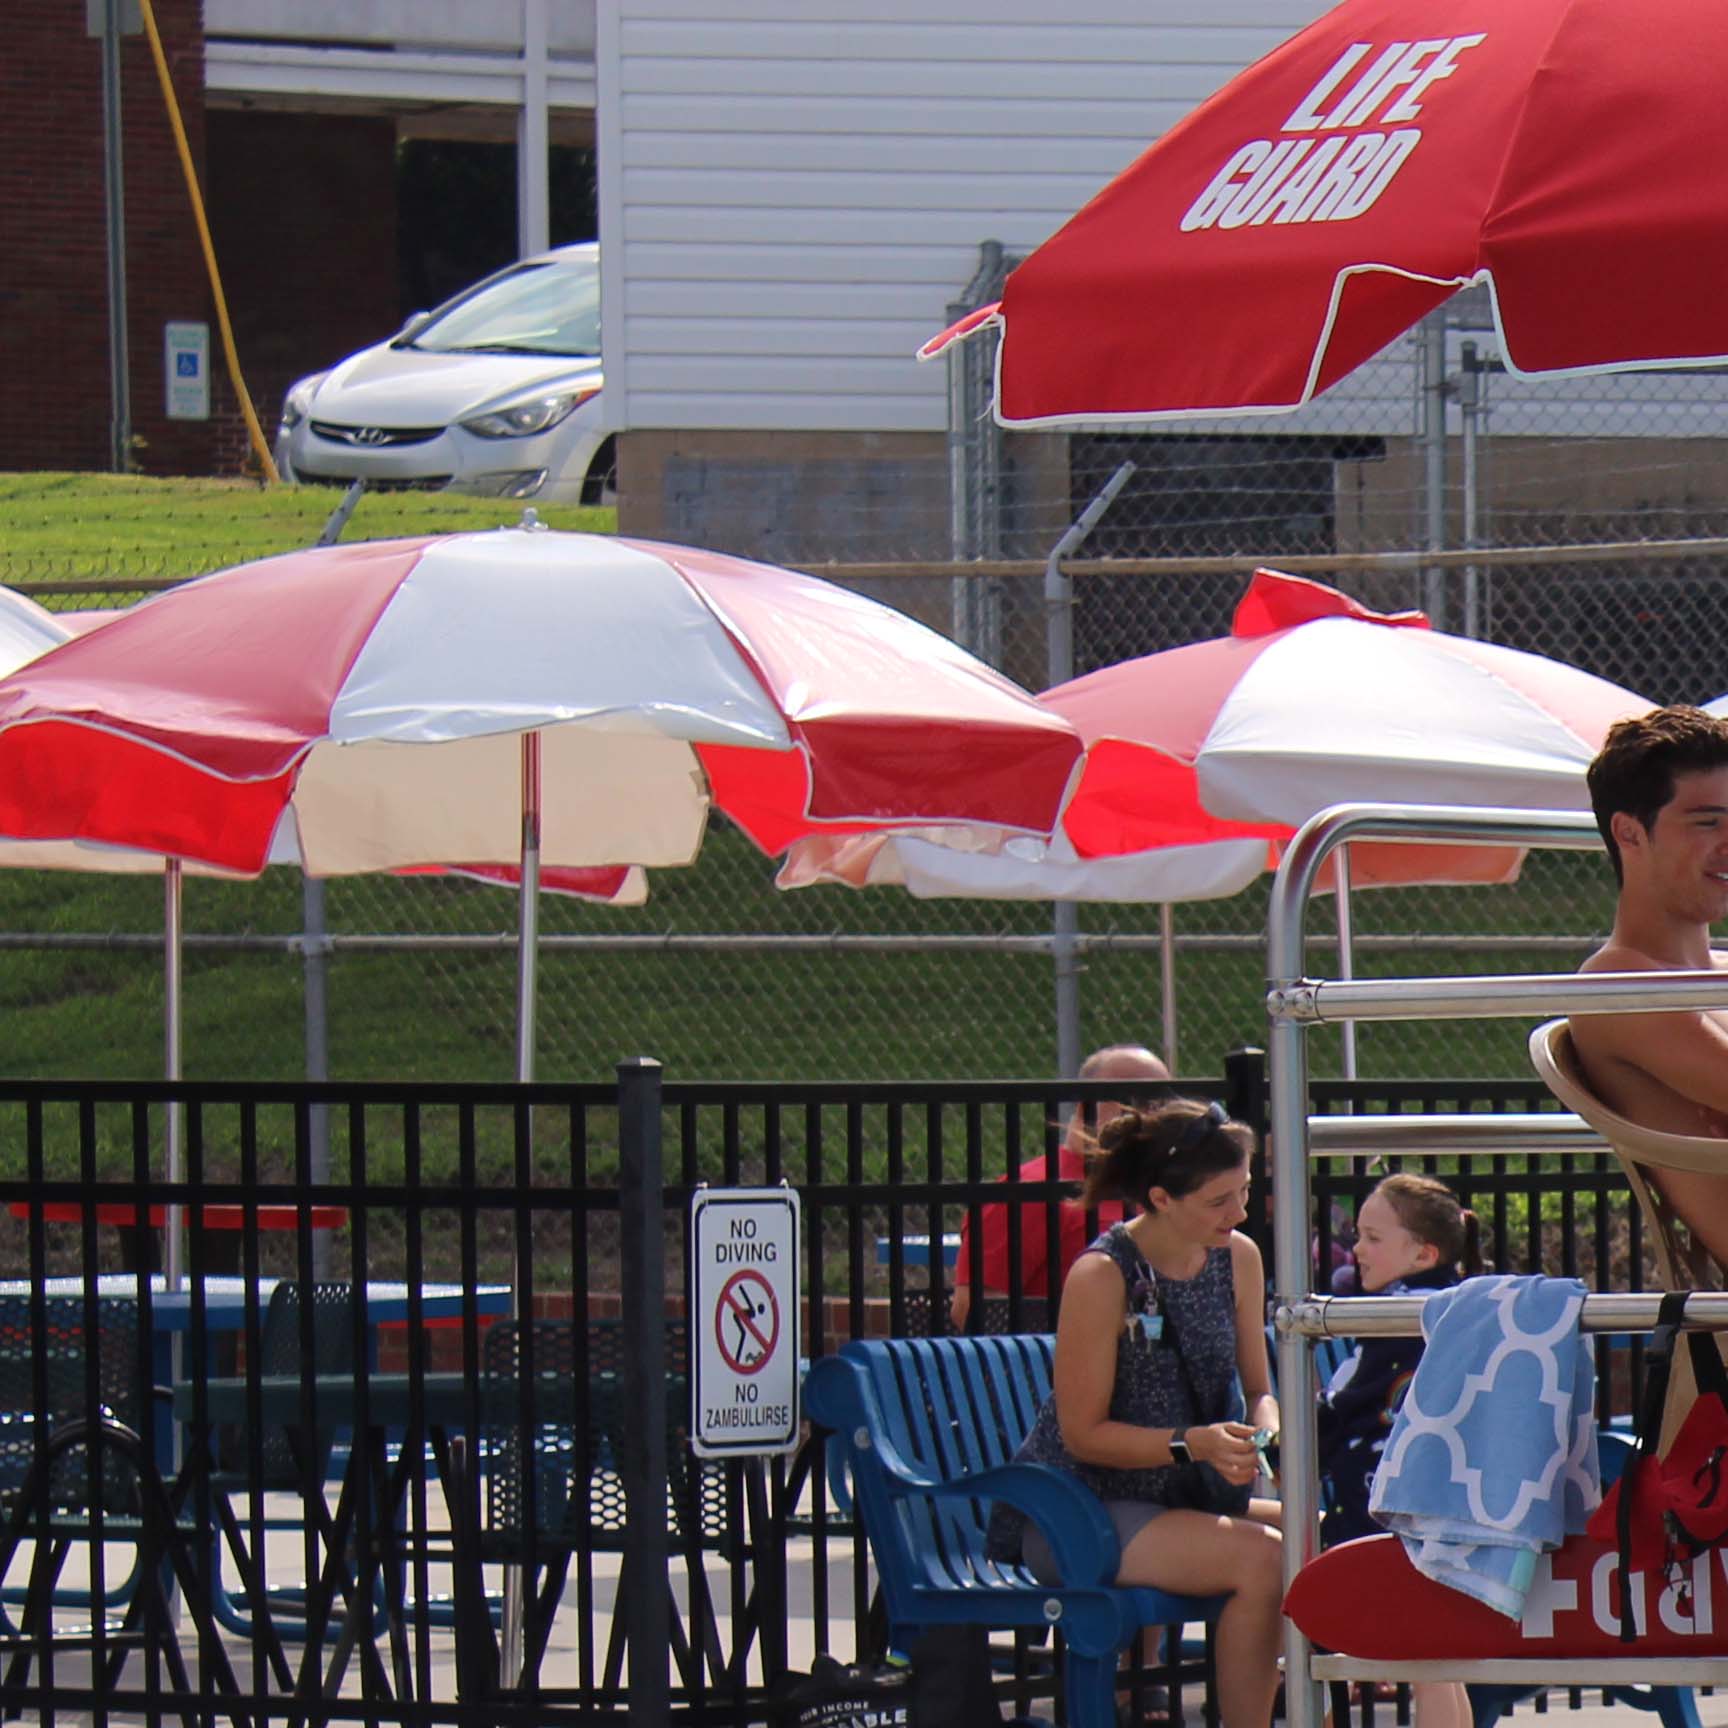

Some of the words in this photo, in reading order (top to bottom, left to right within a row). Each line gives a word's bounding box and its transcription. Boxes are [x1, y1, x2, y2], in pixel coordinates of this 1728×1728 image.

[1279, 32, 1488, 132] LIFE
[1180, 128, 1422, 232] GUARD
[730, 1219, 757, 1239] NO
[715, 1243, 777, 1264] DIVING
[735, 1383, 759, 1404] NO
[705, 1405, 789, 1430] ZAMBULLIRSE
[822, 1701, 869, 1714] INCOME
